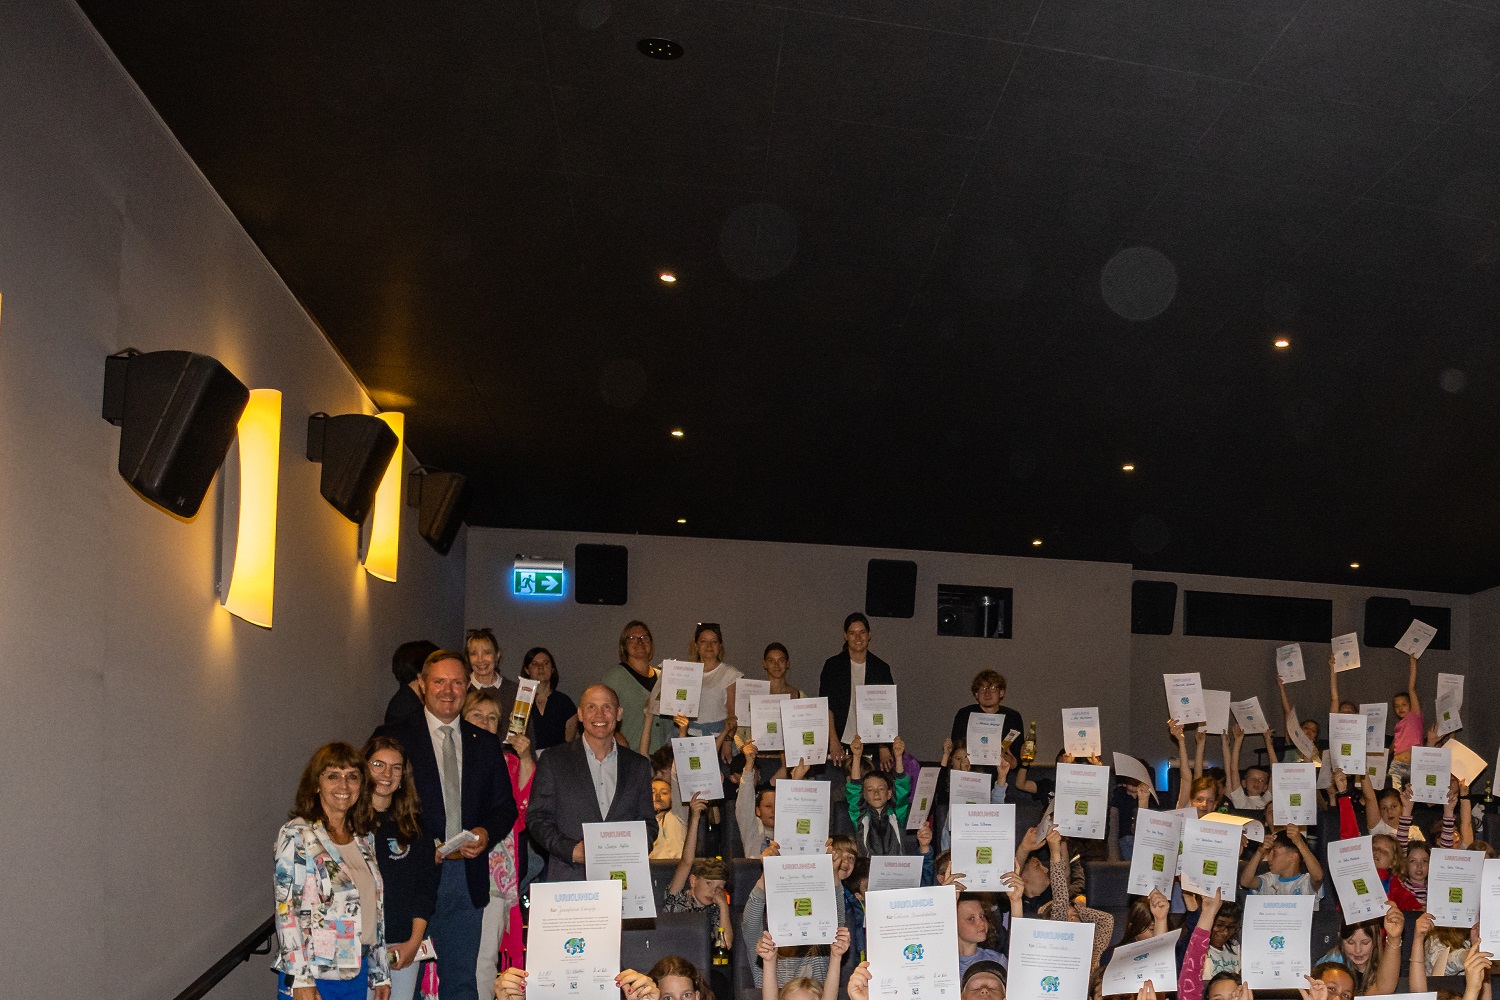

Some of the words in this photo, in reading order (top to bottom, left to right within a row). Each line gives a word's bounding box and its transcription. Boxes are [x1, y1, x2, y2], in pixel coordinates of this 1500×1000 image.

[556, 893, 597, 901] URKUNDE
[889, 899, 934, 909] URKUNDE
[1034, 931, 1075, 941] URKUNDE
